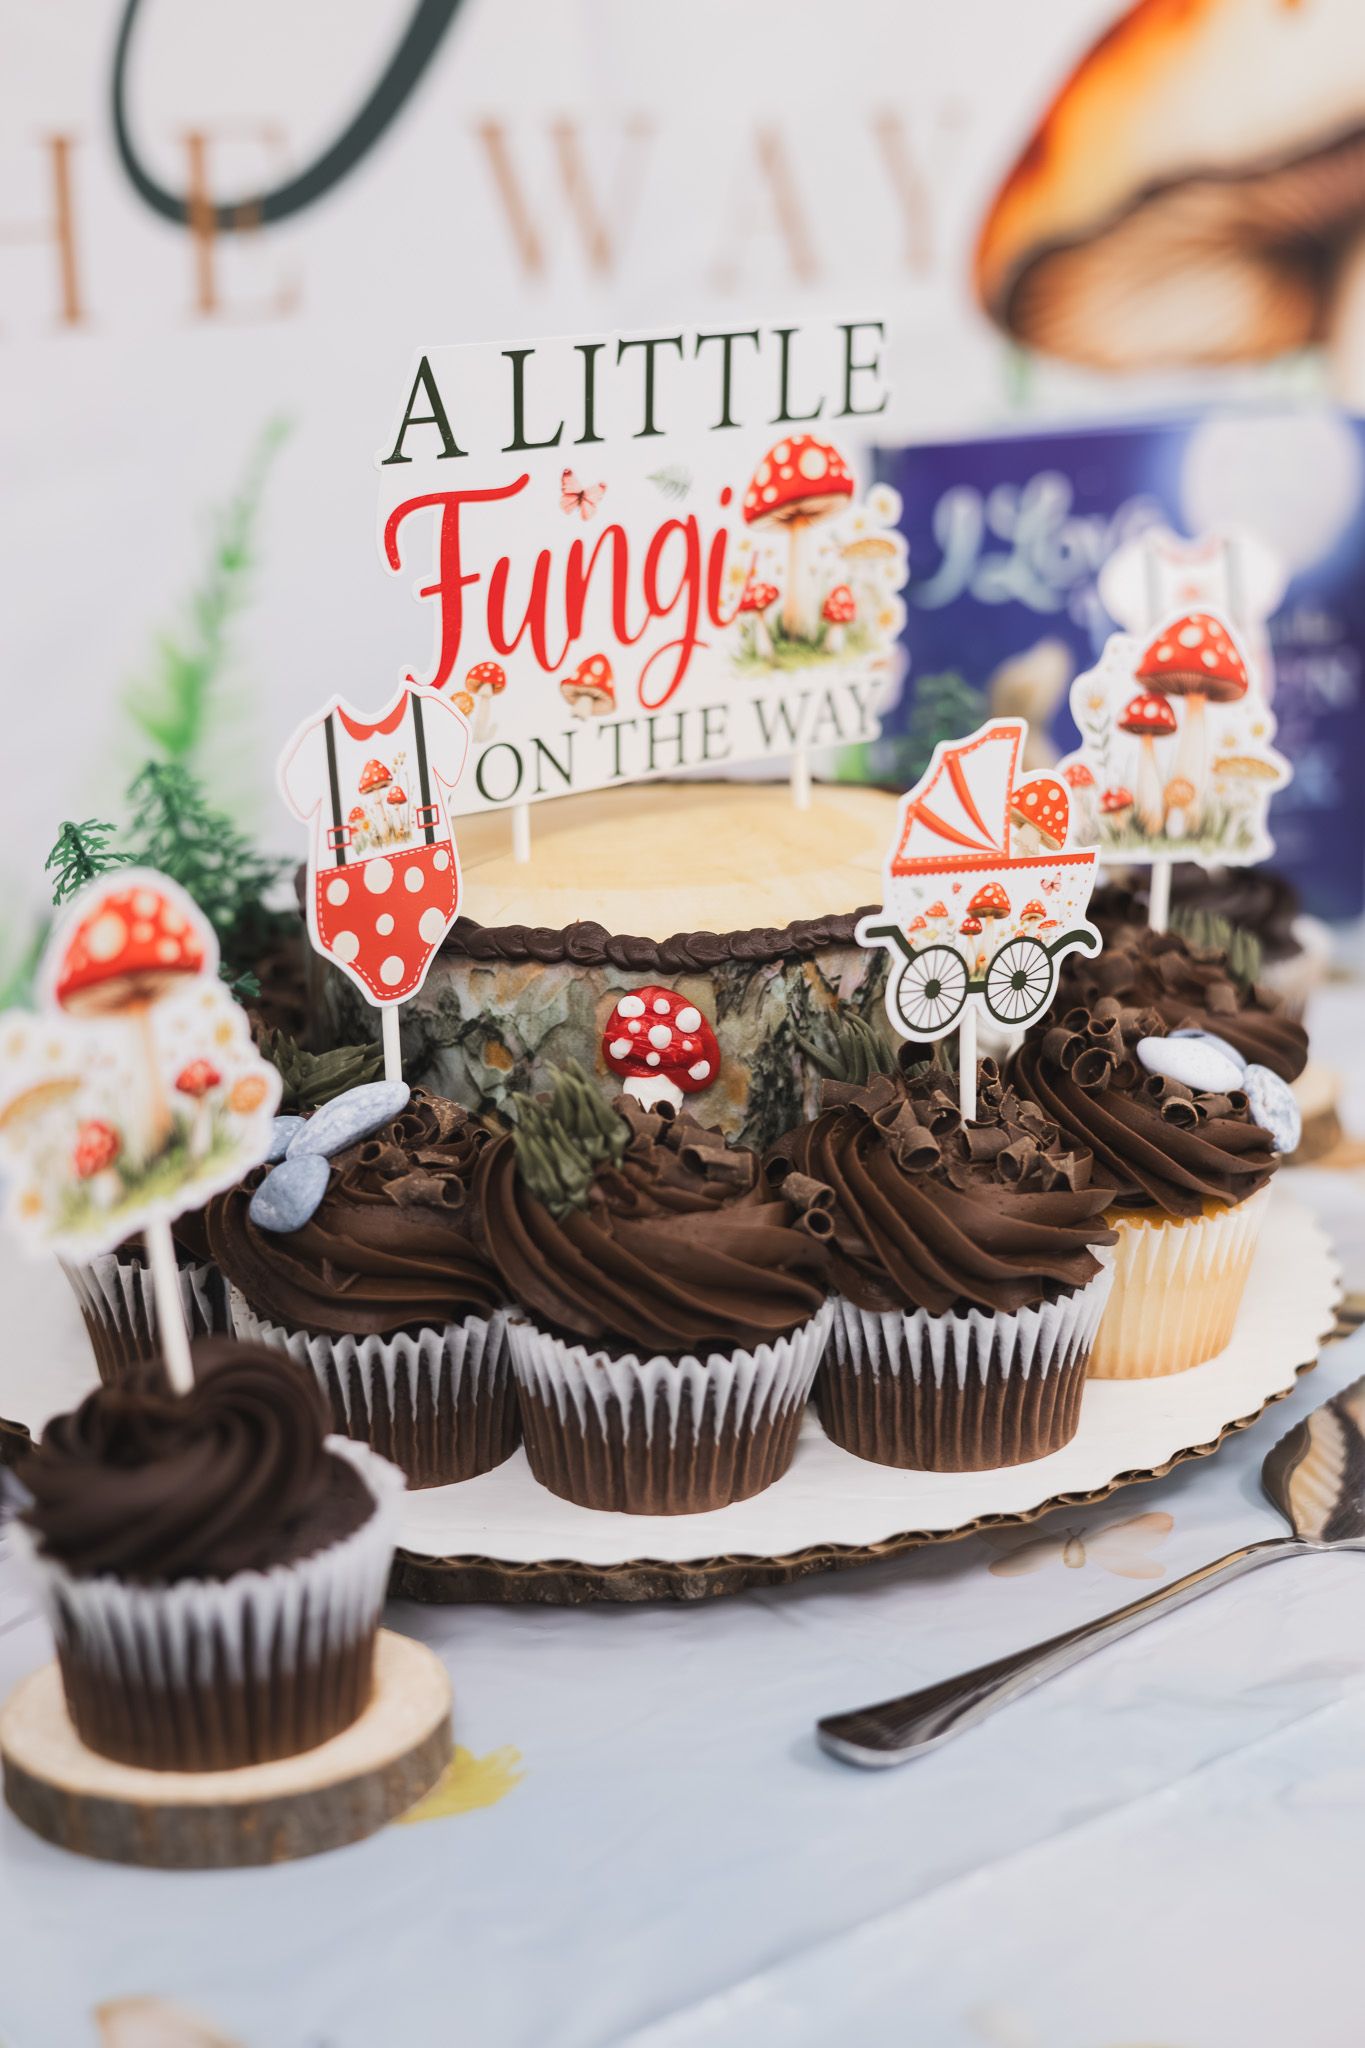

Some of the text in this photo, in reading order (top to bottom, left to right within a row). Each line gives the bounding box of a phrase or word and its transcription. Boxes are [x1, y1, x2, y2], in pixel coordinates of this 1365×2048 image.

[466, 106, 968, 290] WAY
[382, 321, 890, 466] A LITTLE
[384, 473, 757, 709] Fungi
[475, 678, 884, 802] ON THE WAY
